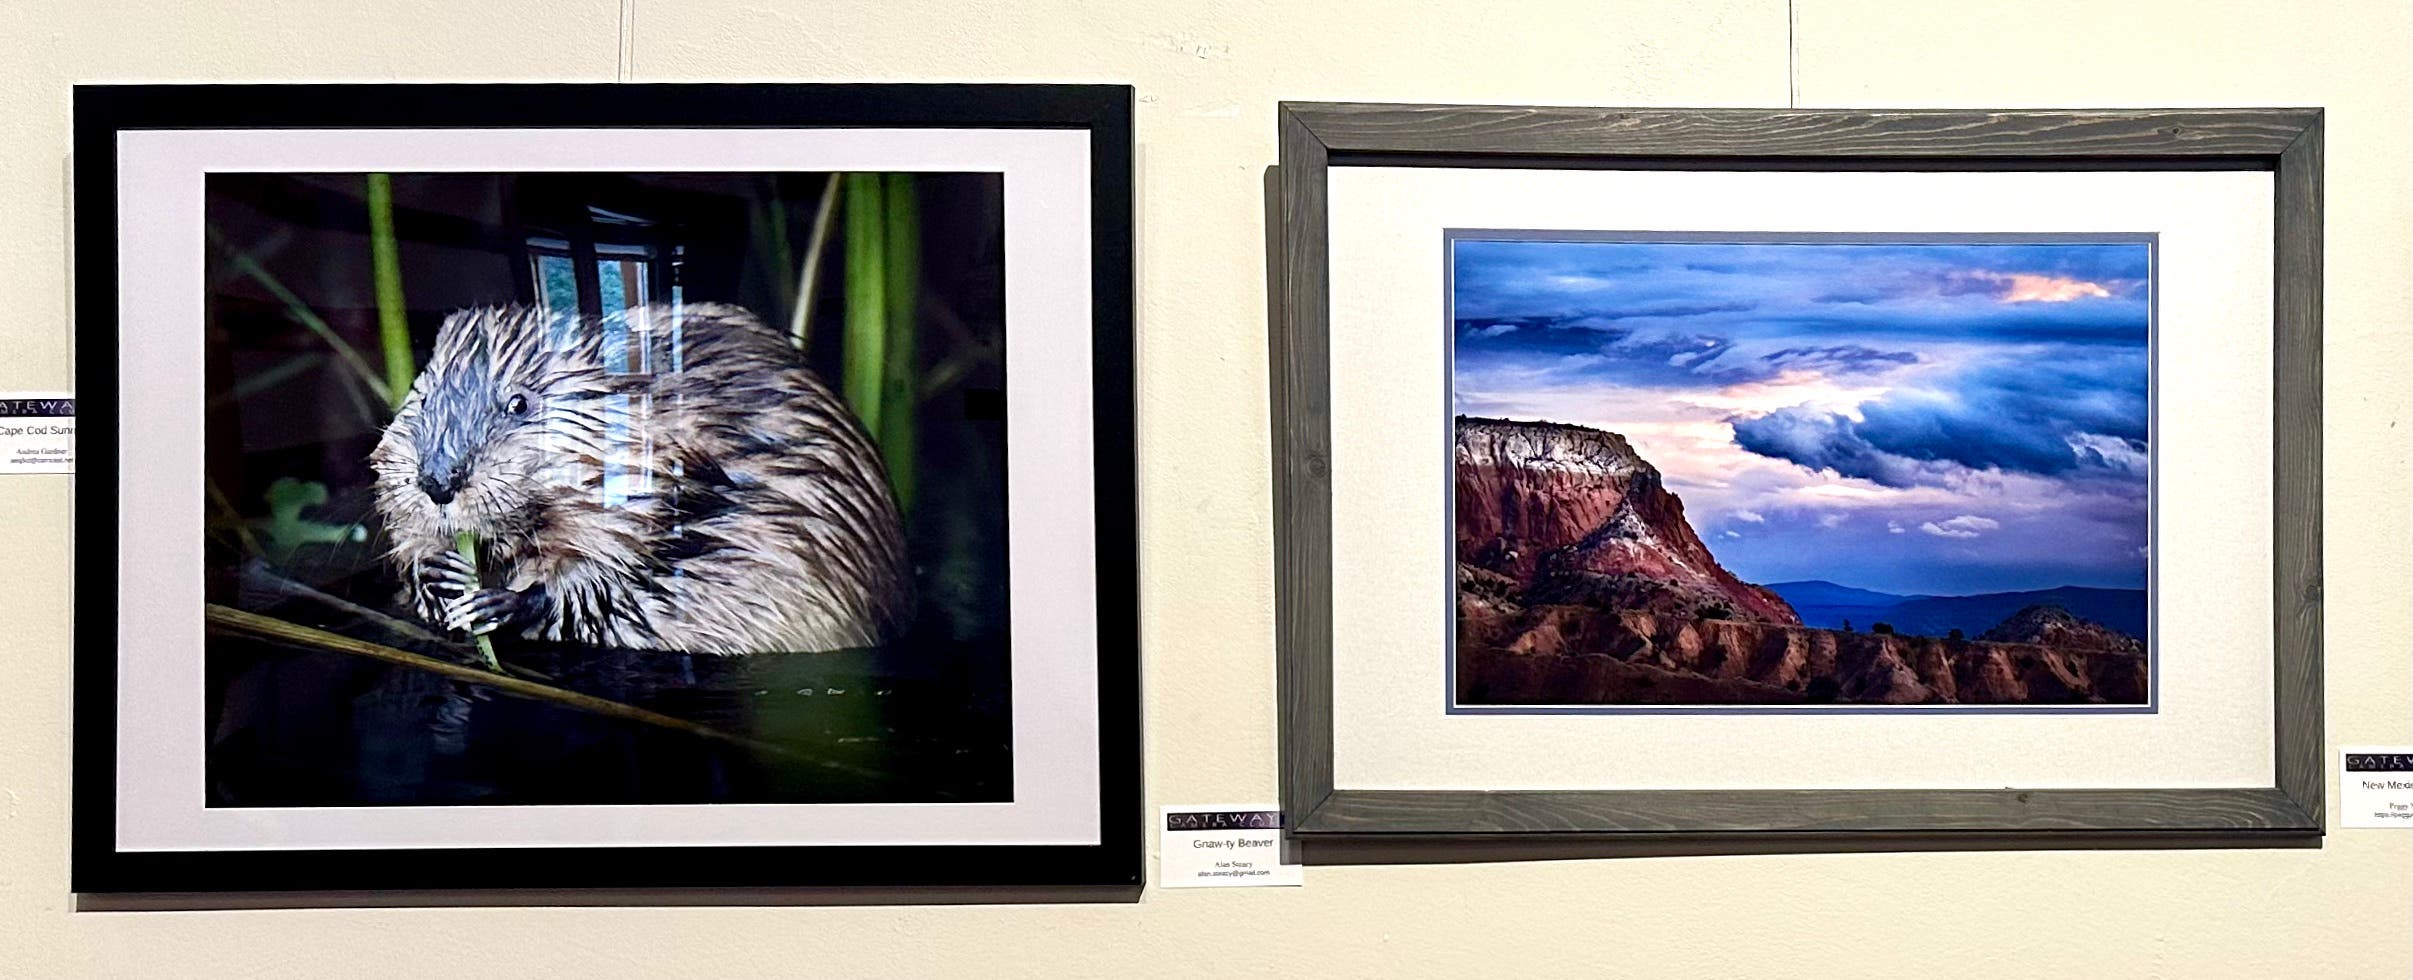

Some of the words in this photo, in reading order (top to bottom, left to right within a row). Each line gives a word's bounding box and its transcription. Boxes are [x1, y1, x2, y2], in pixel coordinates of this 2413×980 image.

[0, 400, 73, 410] ATEWA
[26, 425, 48, 435] Cod
[2362, 780, 2386, 790] New
[1168, 812, 1276, 825] GATEWAY
[1238, 838, 1274, 848] Beaver
